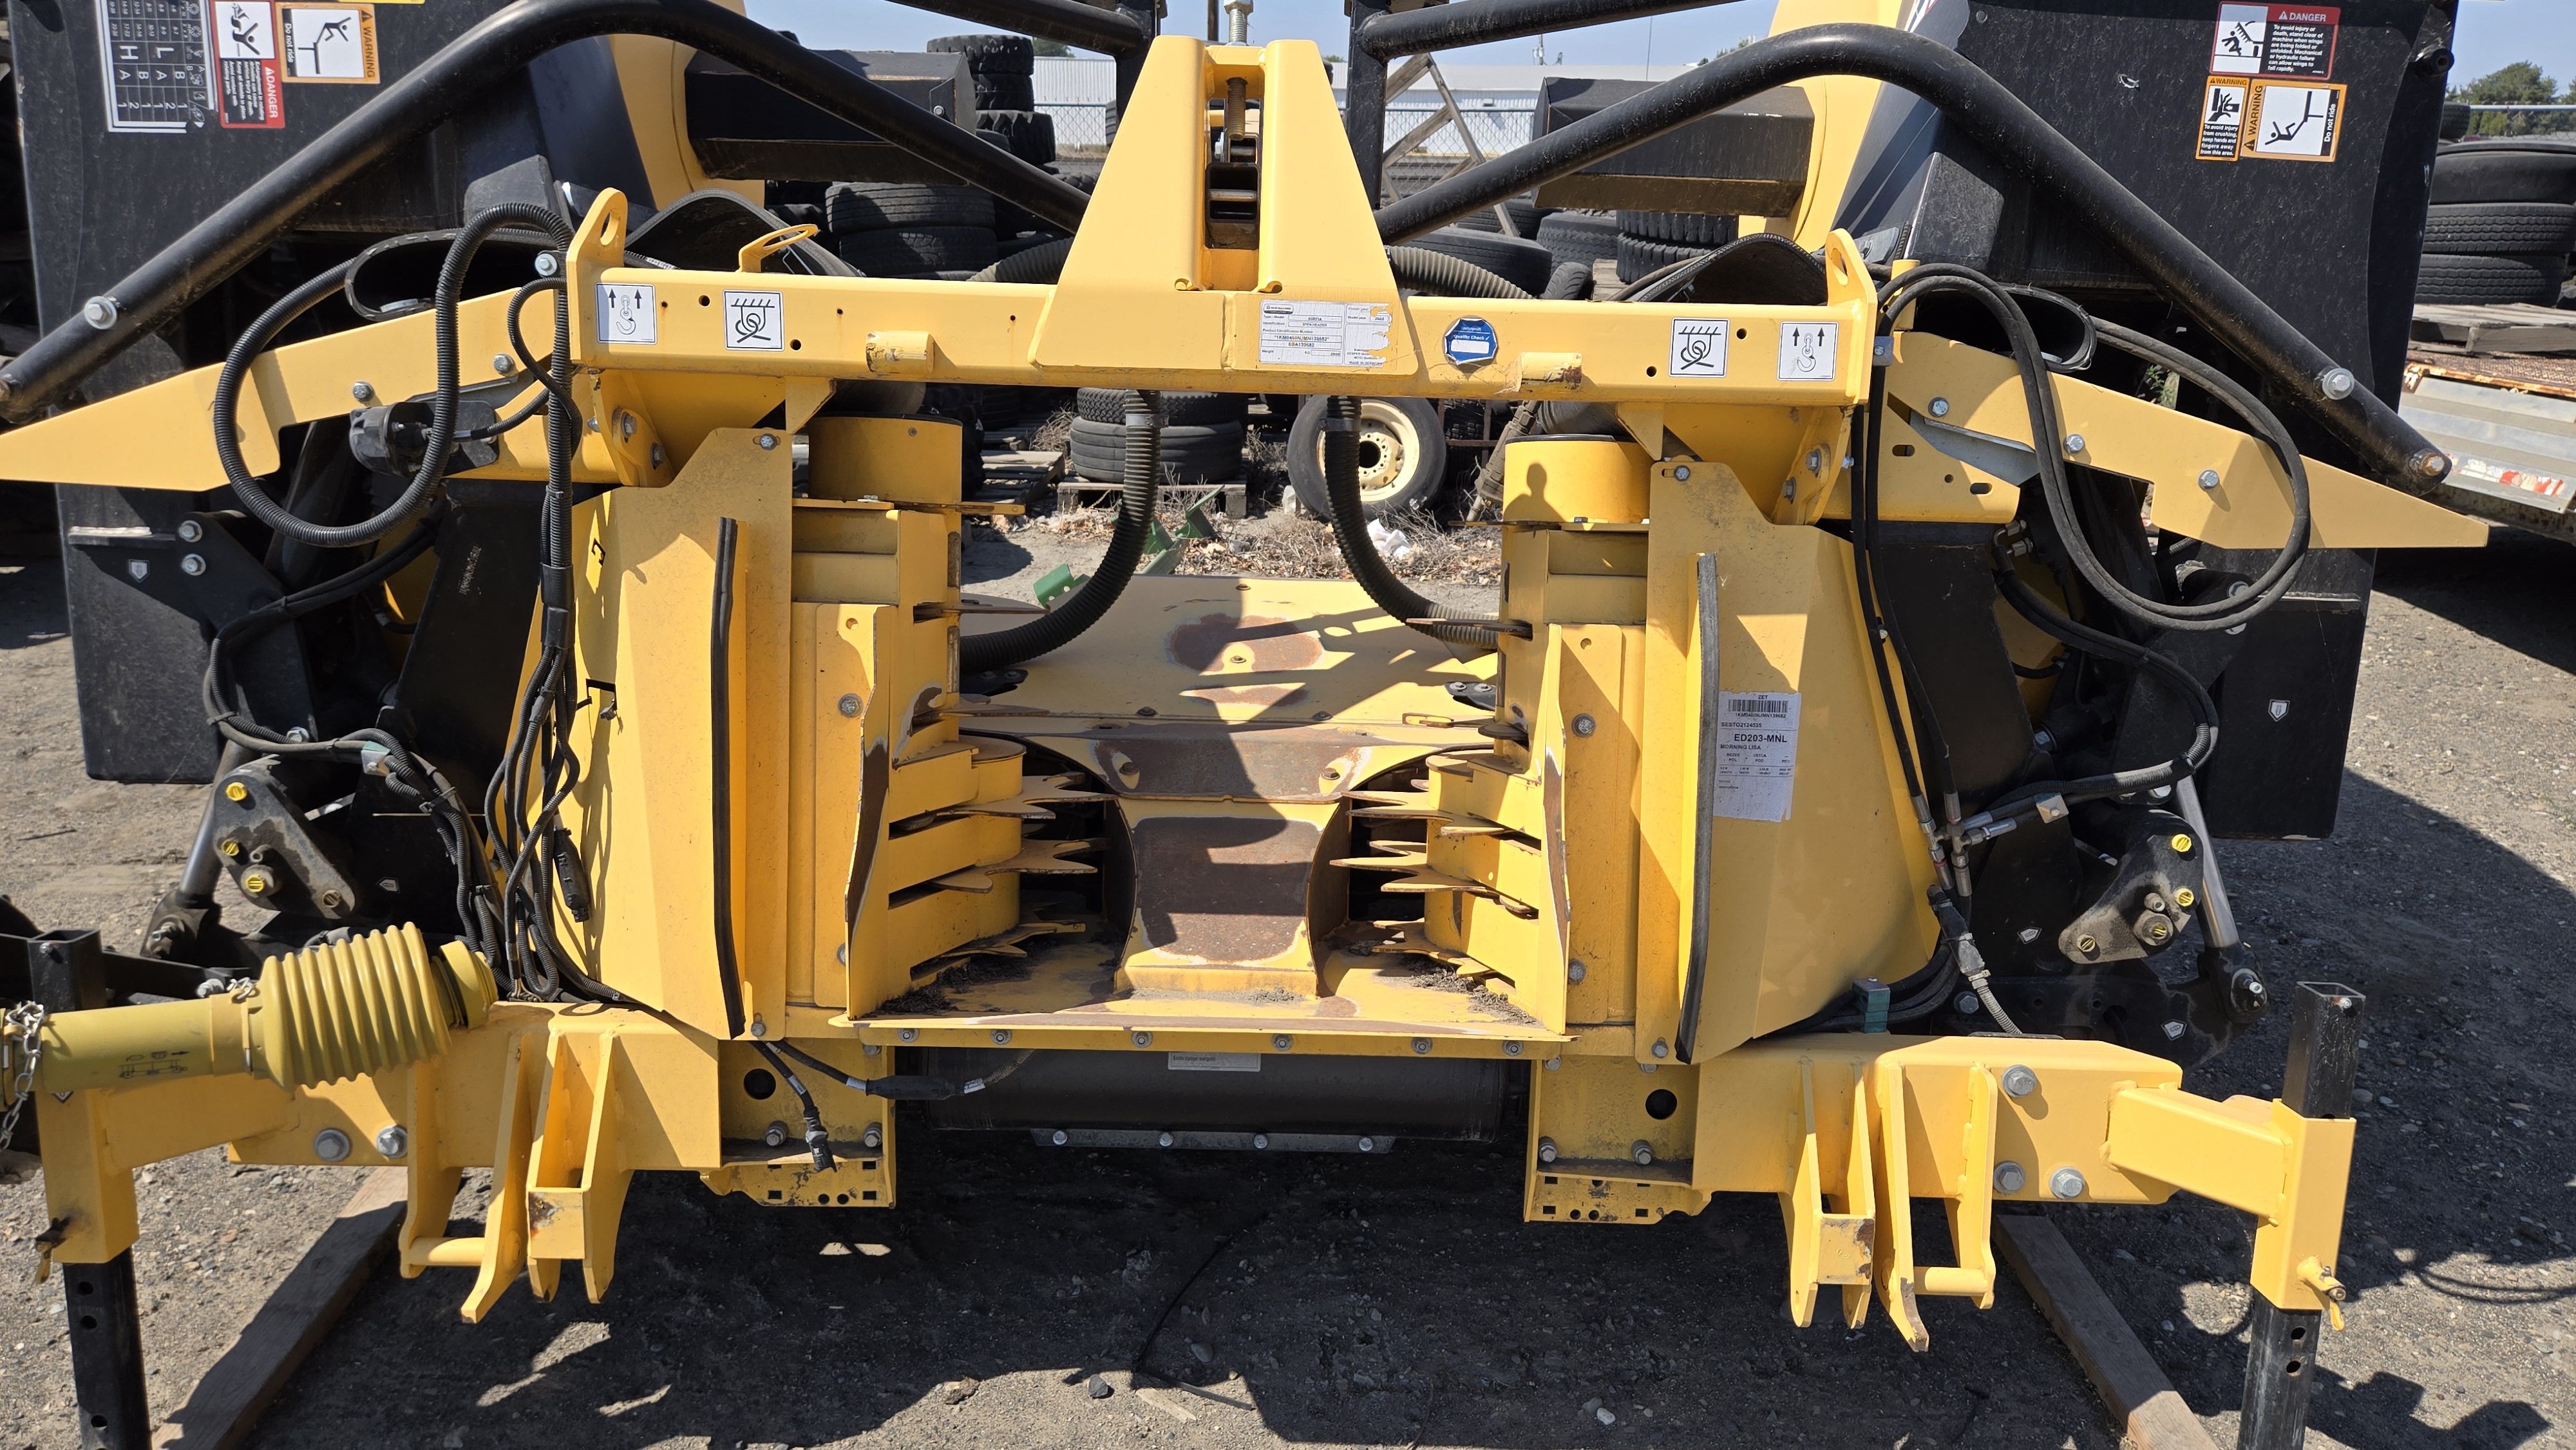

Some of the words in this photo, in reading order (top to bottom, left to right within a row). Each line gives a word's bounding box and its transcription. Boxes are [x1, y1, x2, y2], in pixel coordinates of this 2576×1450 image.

[2289, 12, 2326, 22] DANGER
[285, 23, 292, 33] Do
[286, 35, 294, 48] not
[119, 46, 139, 60] H
[156, 47, 175, 59] L
[363, 26, 375, 78] WARNING
[118, 70, 131, 80] A
[138, 71, 149, 79] B
[156, 70, 167, 80] A
[175, 71, 185, 79] B
[266, 76, 278, 118] DANGER
[2248, 85, 2263, 136] WARNING
[2328, 104, 2336, 117] ride
[2326, 118, 2334, 131] not
[2324, 131, 2332, 142] Do
[1734, 733, 1788, 743] ED203-MNL
